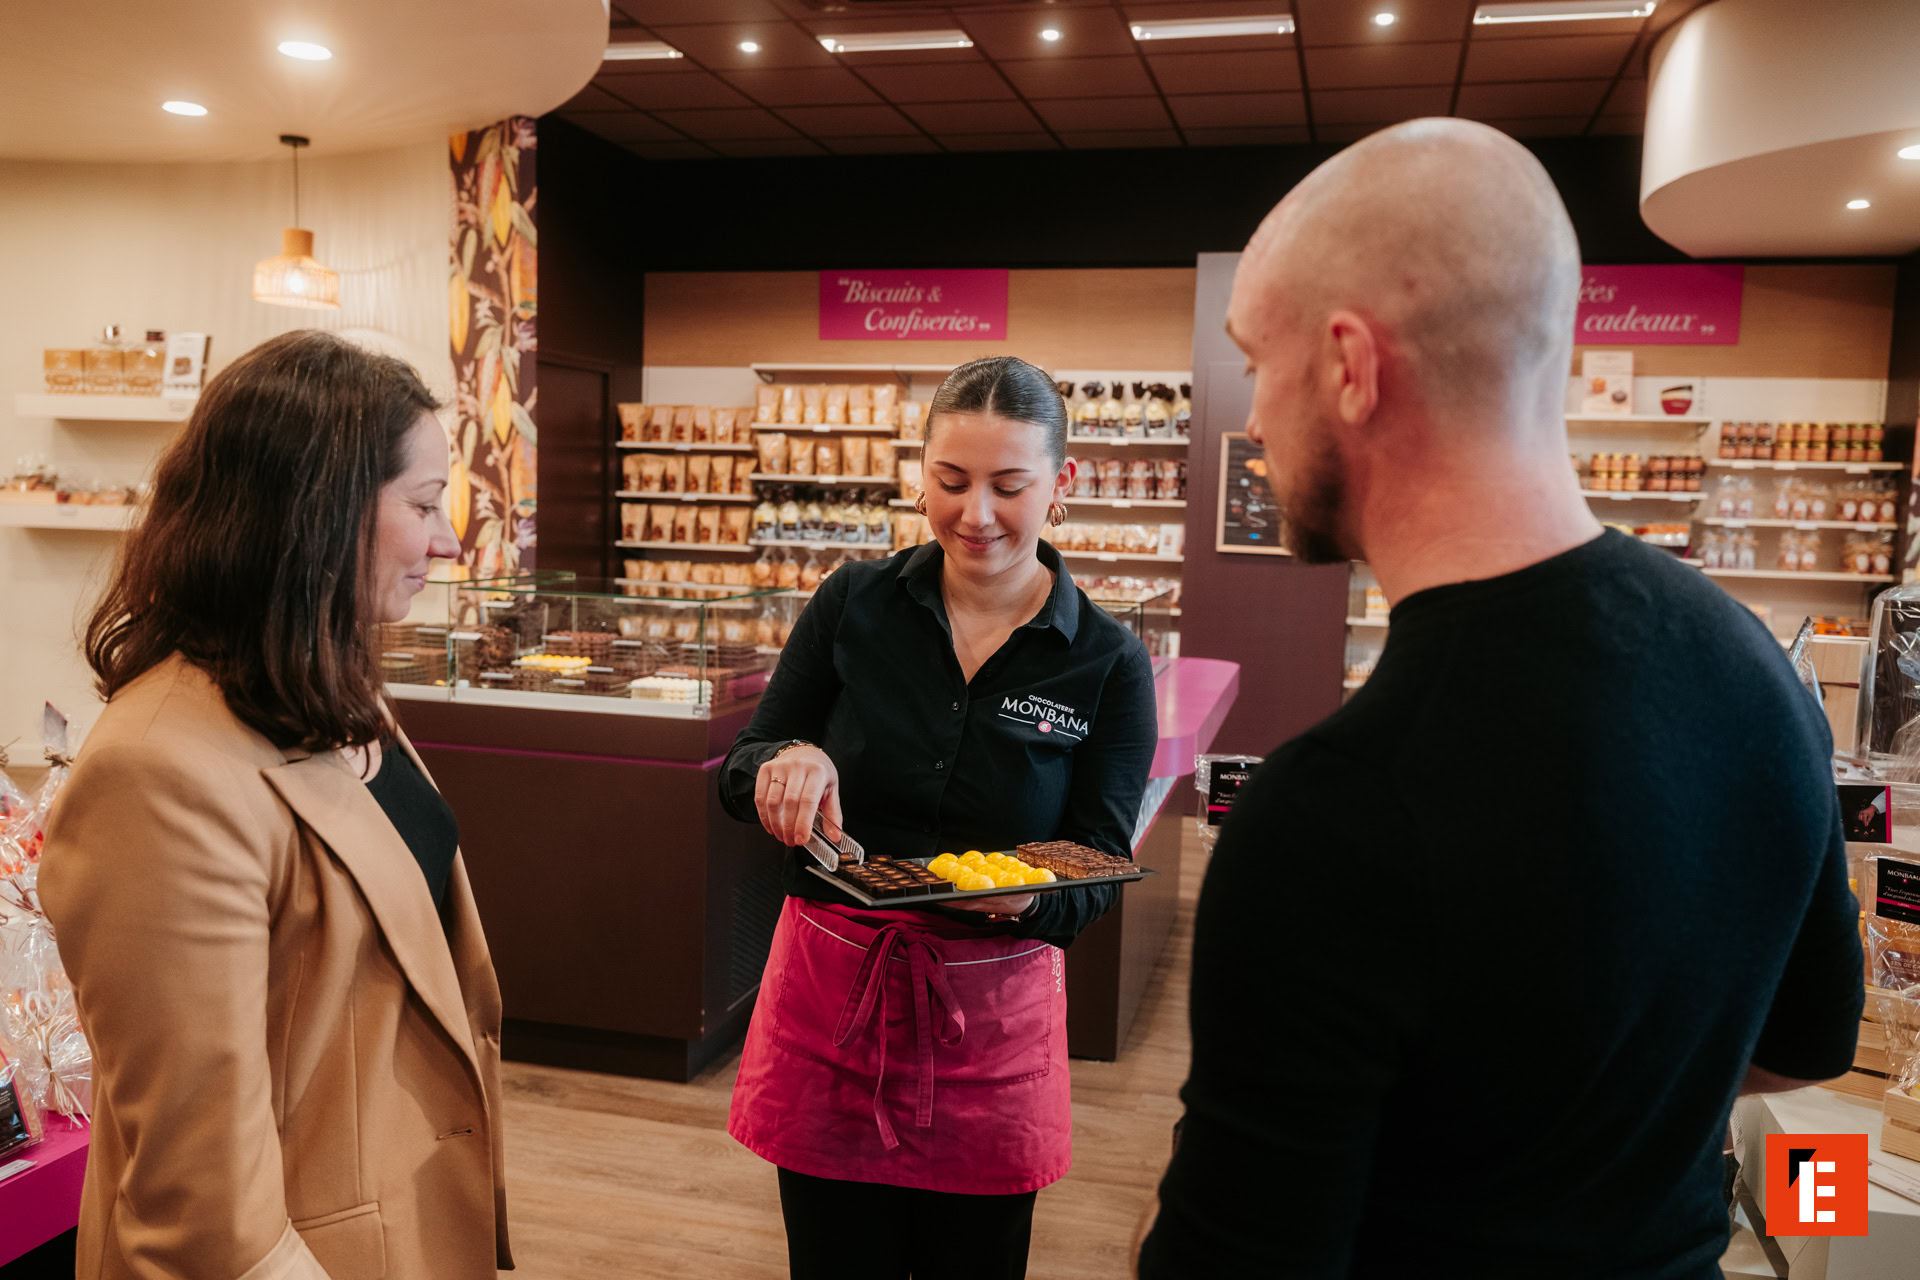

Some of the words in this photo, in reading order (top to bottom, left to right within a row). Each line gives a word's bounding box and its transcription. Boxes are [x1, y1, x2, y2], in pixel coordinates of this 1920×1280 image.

[927, 285, 942, 303] &
[1028, 694, 1075, 714] CHOCOLATERIE
[1001, 696, 1089, 735] MONBANA
